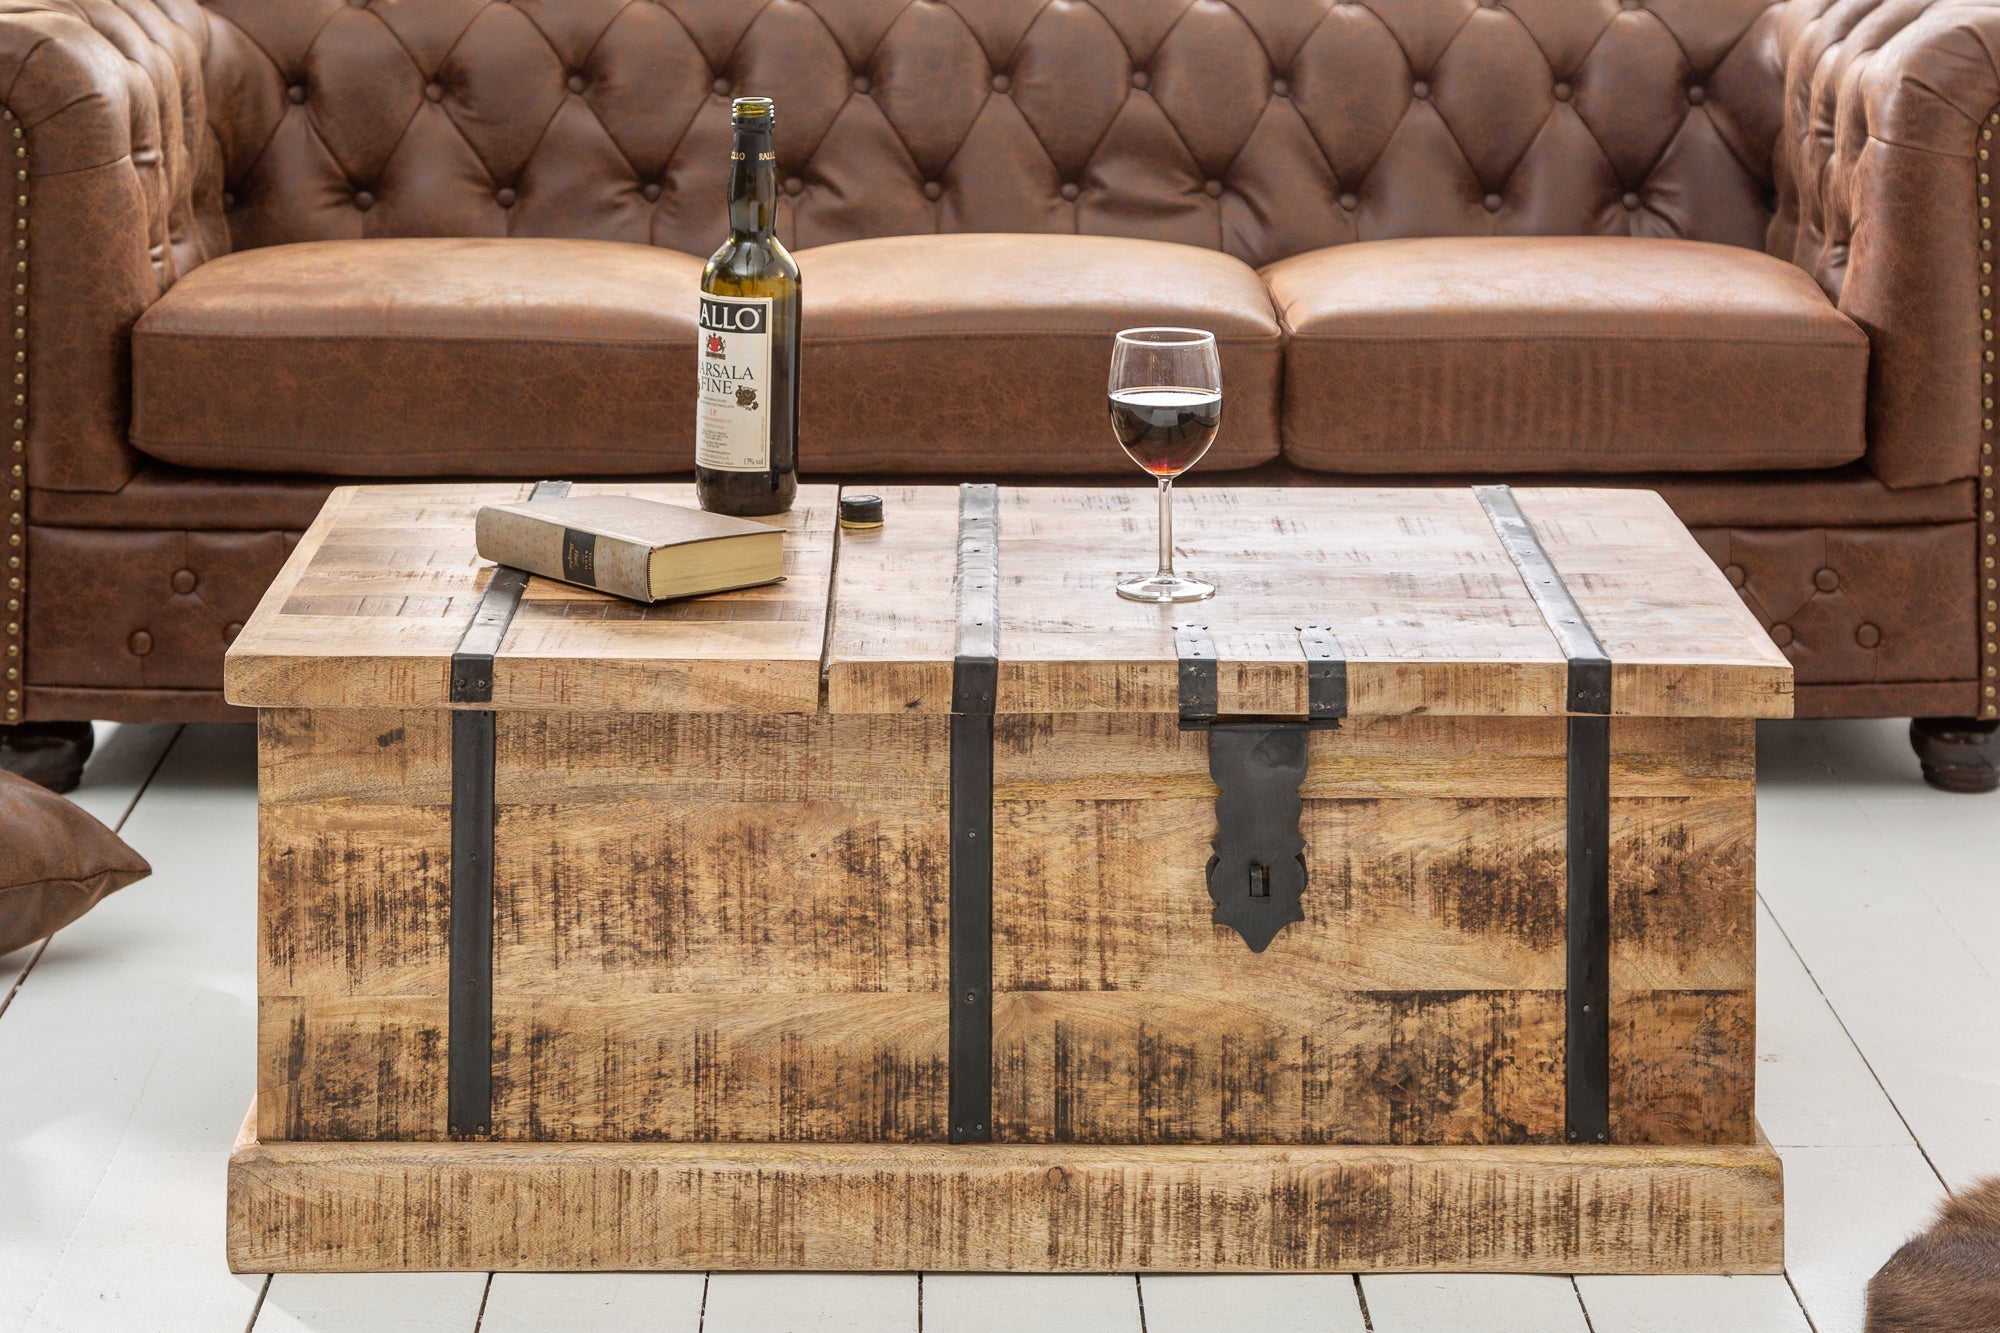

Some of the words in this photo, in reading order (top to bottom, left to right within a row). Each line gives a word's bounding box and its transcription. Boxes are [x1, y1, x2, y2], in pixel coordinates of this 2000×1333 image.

[700, 302, 760, 331] ALLO
[699, 361, 754, 380] ARSALA
[701, 377, 733, 395] FINE
[755, 457, 764, 465] vol
